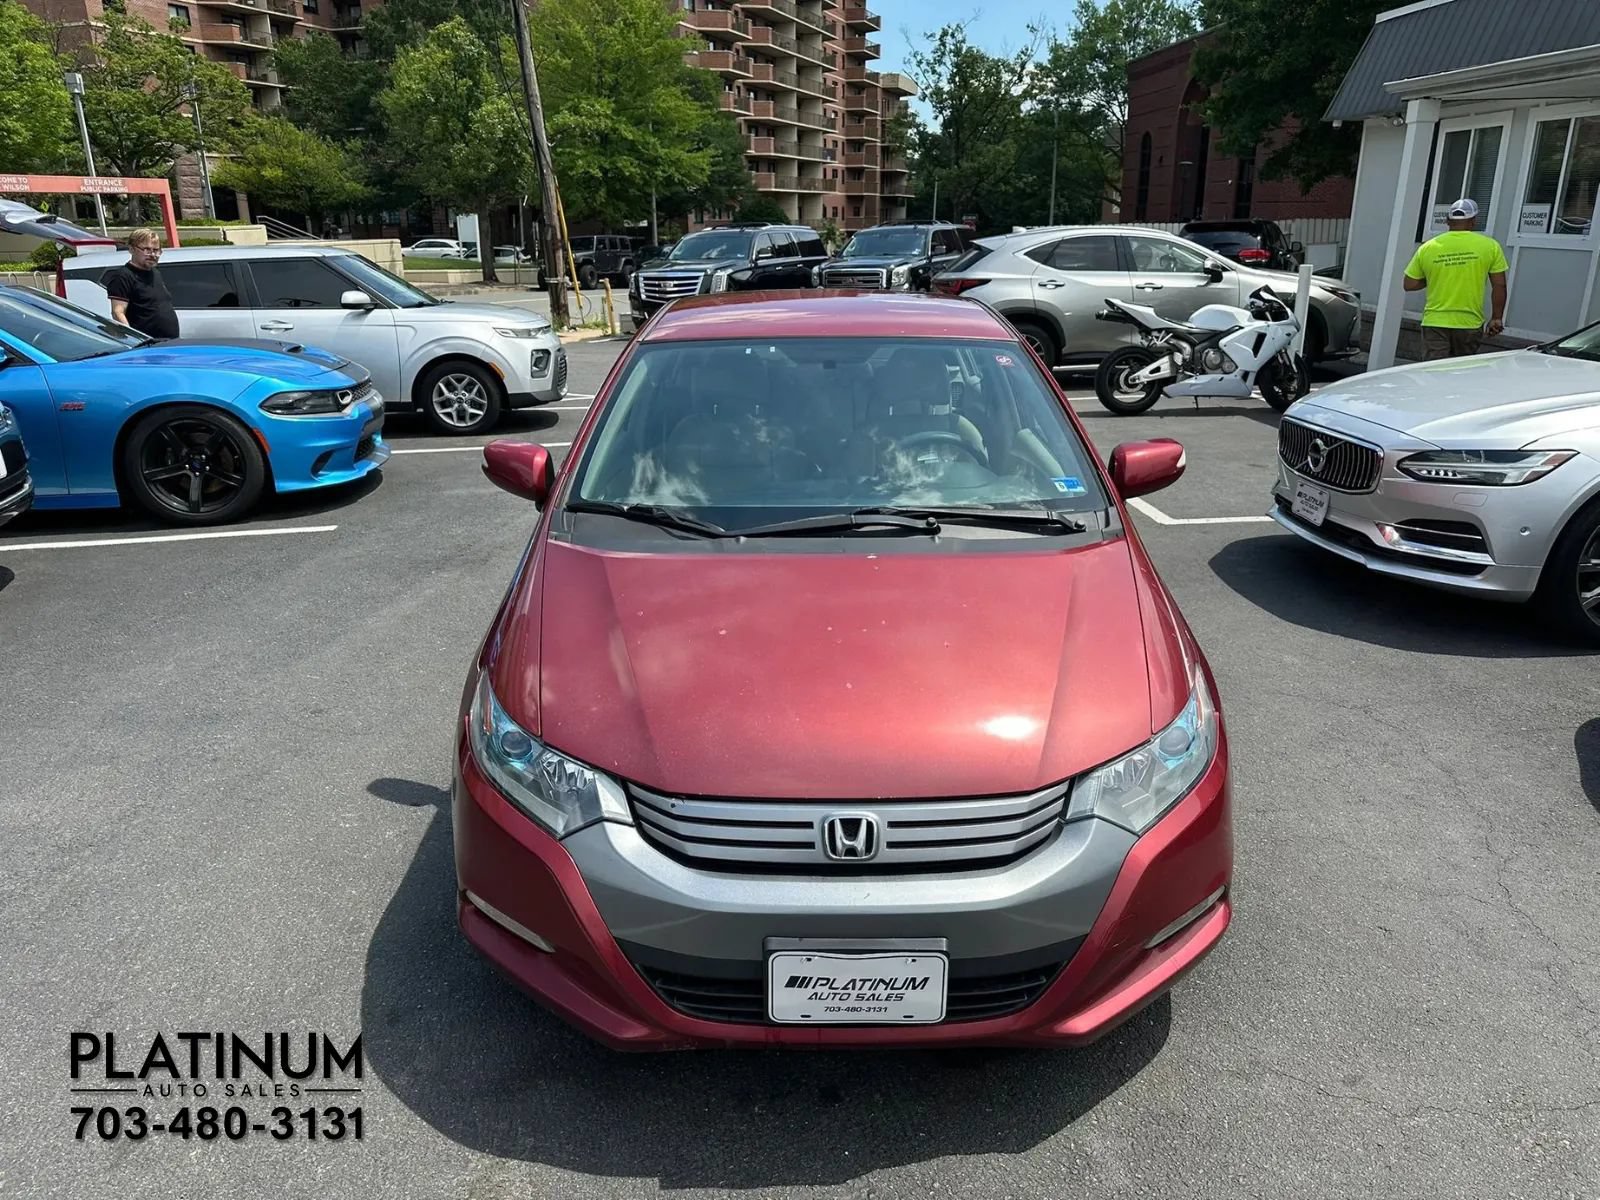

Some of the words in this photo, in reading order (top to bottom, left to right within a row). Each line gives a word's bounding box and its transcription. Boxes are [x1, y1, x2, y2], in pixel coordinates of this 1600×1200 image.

[2, 184, 30, 192] WILSON
[811, 976, 930, 991] PLATINUM
[807, 992, 851, 1001] AUTO
[854, 992, 906, 1002] SALES
